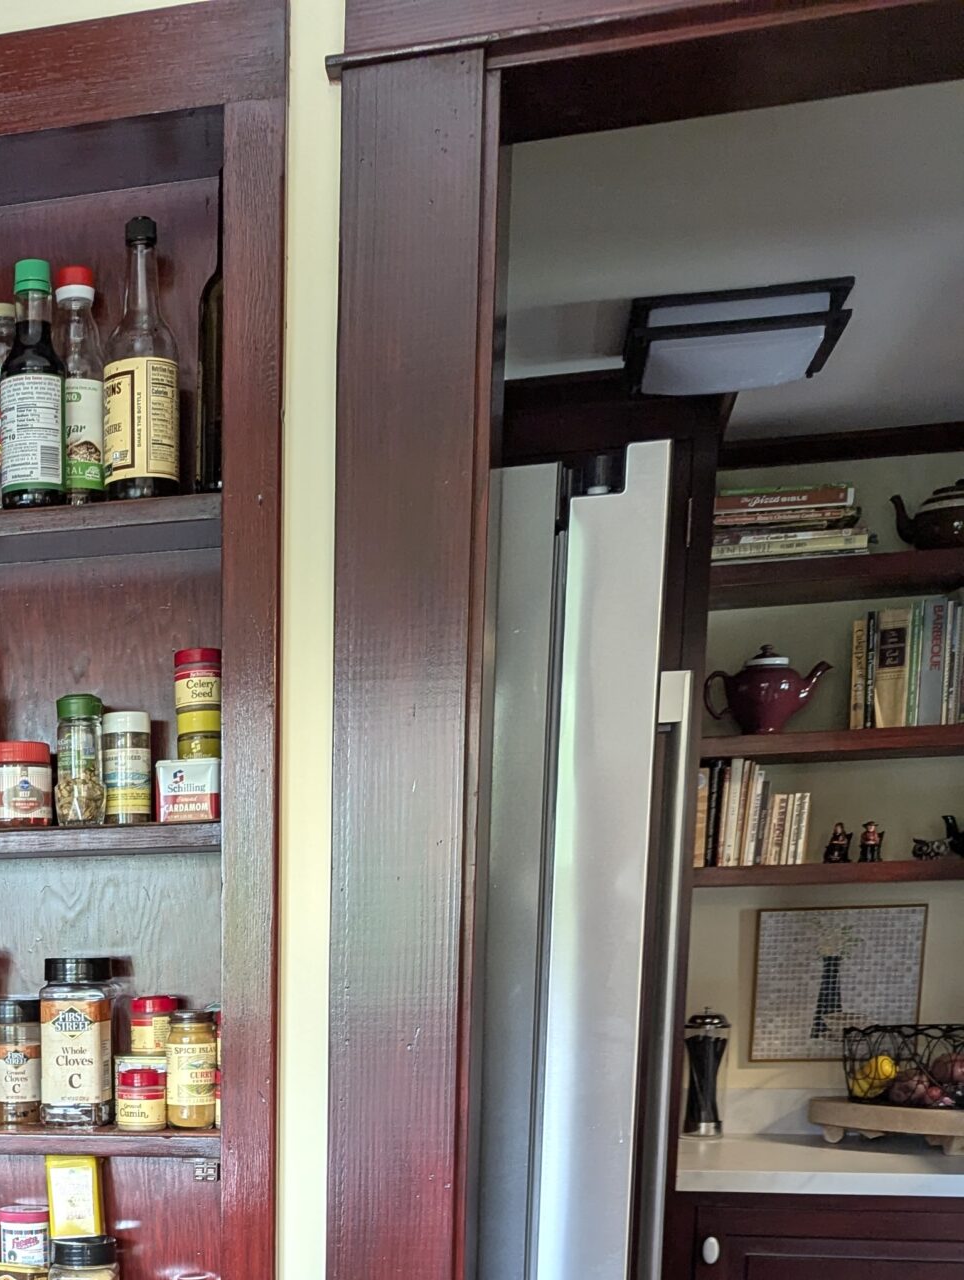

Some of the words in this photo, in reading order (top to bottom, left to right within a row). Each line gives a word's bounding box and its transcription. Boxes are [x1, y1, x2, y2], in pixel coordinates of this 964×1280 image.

[65, 424, 86, 439] gar
[780, 494, 808, 502] BIBLE
[929, 604, 944, 671] BARBEQUE
[186, 680, 217, 691] Celery
[191, 688, 214, 698] Seed
[167, 783, 206, 794] Schilling
[165, 802, 209, 813] CARDAMOM
[59, 1011, 86, 1022] FIRST
[54, 1021, 92, 1033] STREET
[61, 1046, 88, 1056] Whole
[174, 1046, 197, 1055] SPICE
[55, 1055, 94, 1067] Cloves
[4, 1075, 29, 1083] Cloves
[68, 1073, 83, 1089] C
[12, 1084, 22, 1094] C
[119, 1108, 149, 1119] Cumin
